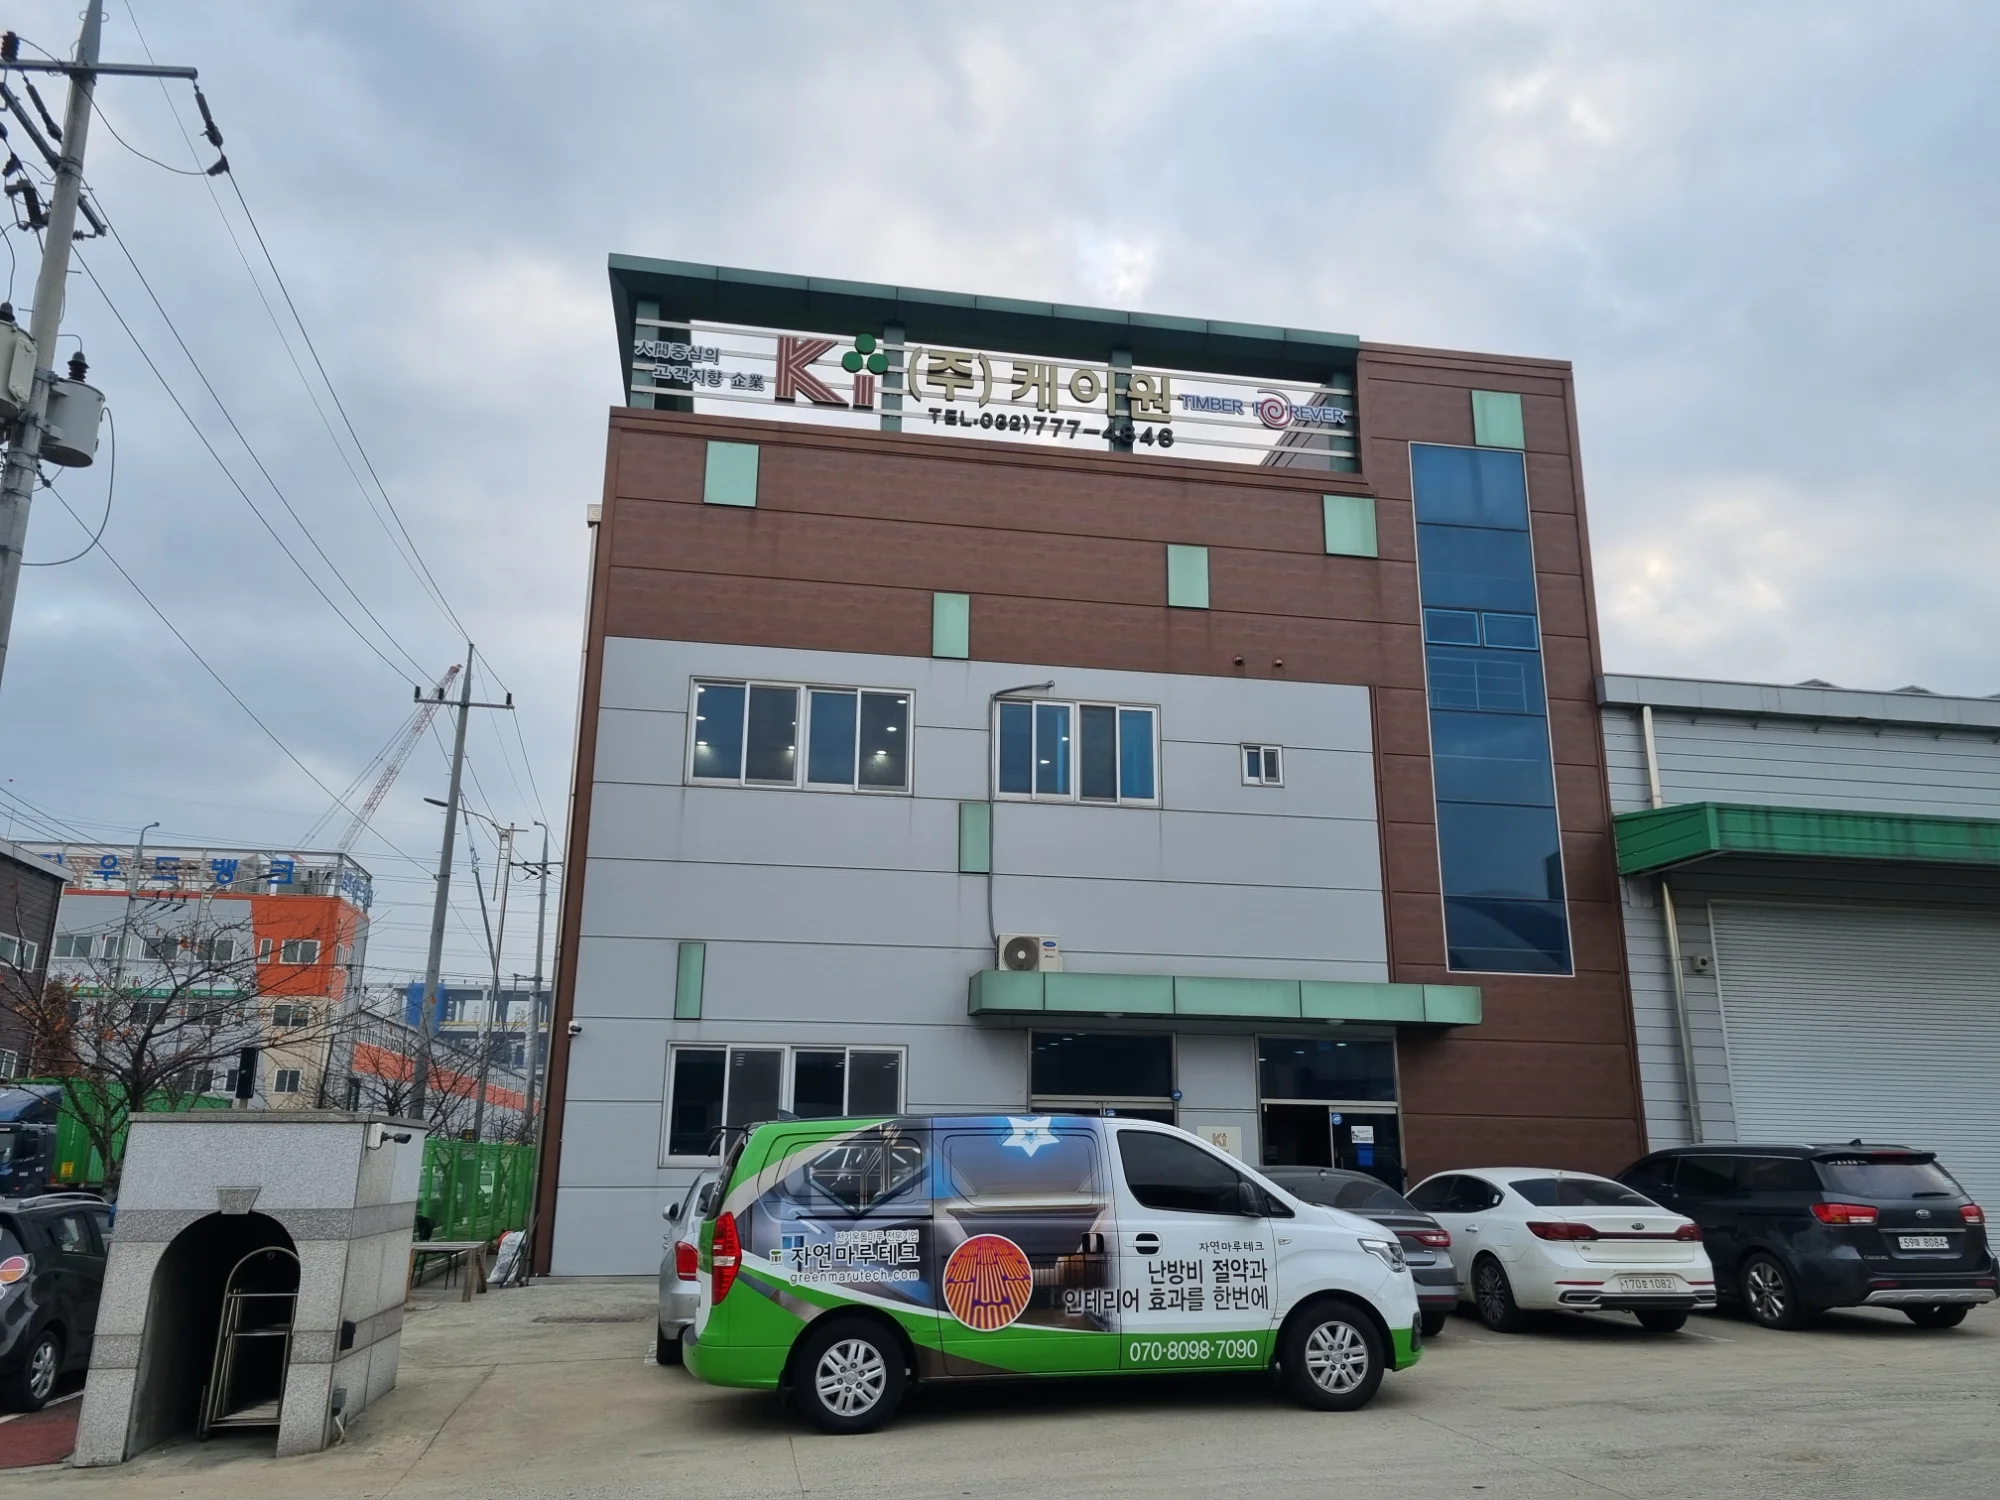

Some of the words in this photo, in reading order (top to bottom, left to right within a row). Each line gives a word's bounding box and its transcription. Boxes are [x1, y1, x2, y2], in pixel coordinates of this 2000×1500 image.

[635, 341, 720, 364] 人間중심의
[652, 363, 724, 387] 고객지향
[730, 372, 765, 392] 企業
[1179, 393, 1244, 415] TIMBER
[886, 1229, 919, 1243] 전문기업
[1199, 1240, 1265, 1254] 자연마루테크
[791, 1242, 919, 1269] 자연마루테크
[790, 1269, 919, 1285] greenmarutech.com
[1148, 1259, 1203, 1284] 난방비
[1212, 1258, 1268, 1283] 절약과
[1649, 1279, 1673, 1289] 1082
[1064, 1288, 1139, 1315] 인테리어
[1148, 1286, 1205, 1312] 효과를
[1213, 1285, 1269, 1310] 한번에
